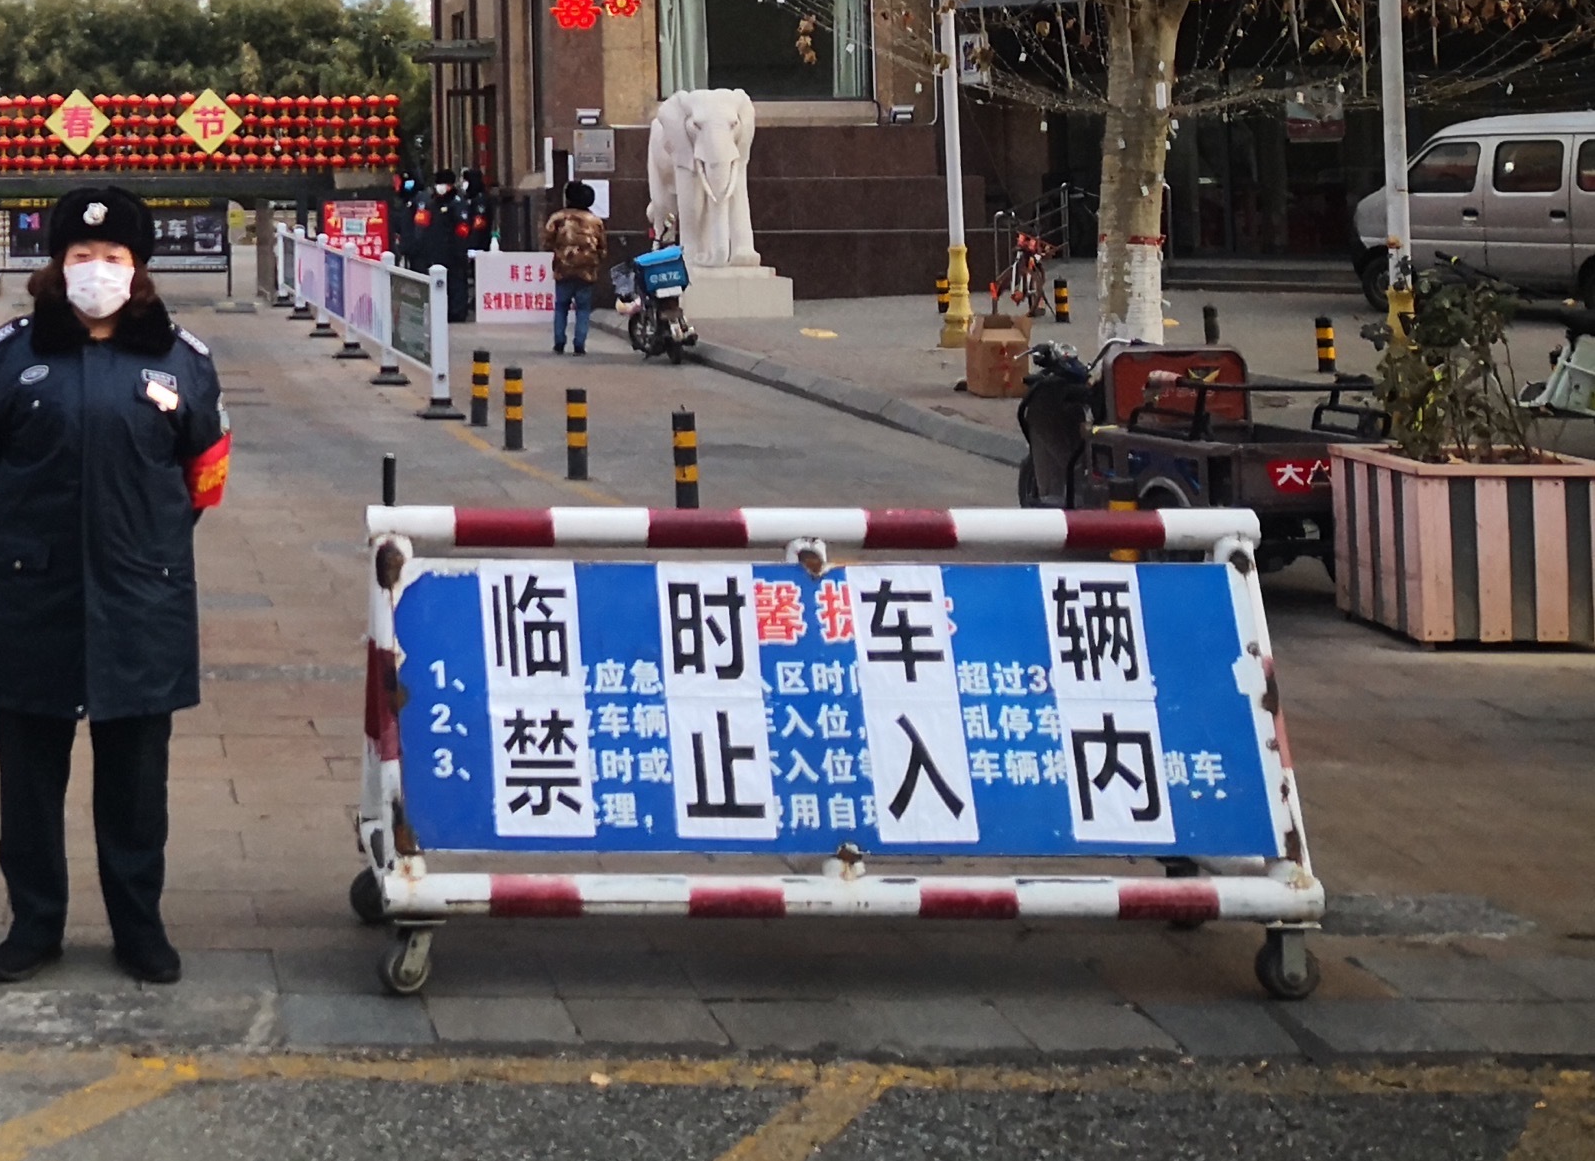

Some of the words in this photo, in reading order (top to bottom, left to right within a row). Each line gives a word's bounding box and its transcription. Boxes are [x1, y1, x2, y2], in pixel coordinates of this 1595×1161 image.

[59, 102, 228, 138] 春节
[492, 574, 1140, 684] 临时车辆
[502, 708, 1163, 823] 禁止入内
